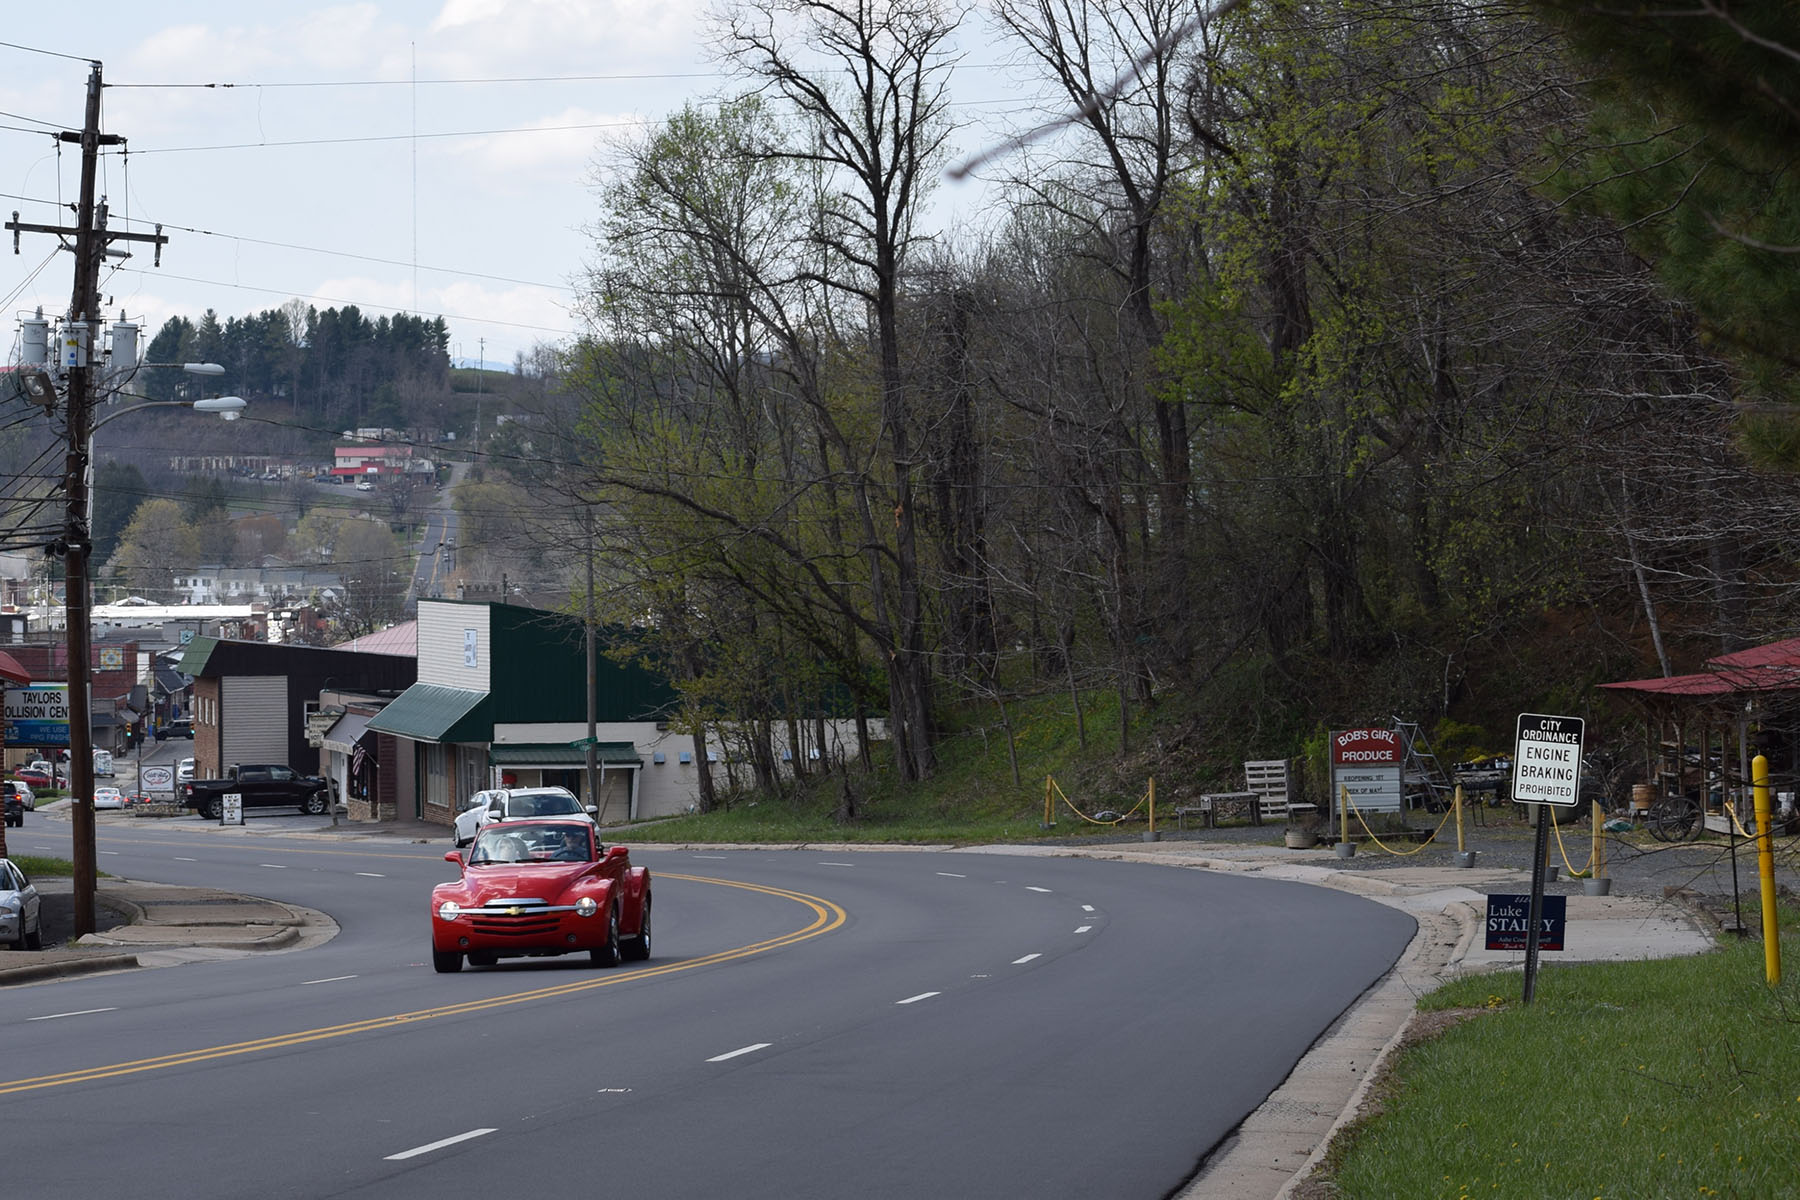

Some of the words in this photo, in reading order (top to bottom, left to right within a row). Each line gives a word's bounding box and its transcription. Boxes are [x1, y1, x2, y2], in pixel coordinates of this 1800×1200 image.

[22, 692, 61, 704] TAYLORS
[5, 706, 45, 718] OLLISION
[1540, 719, 1562, 731] CITY
[1338, 730, 1368, 746] BOB'S
[1370, 730, 1395, 744] GIRL
[1523, 730, 1578, 743] ORDINANCE
[1342, 750, 1393, 761] PRODUCE
[1526, 747, 1571, 762] ENGINE
[1521, 765, 1573, 781] BRAKING
[1519, 783, 1572, 797] PROHIBITED
[1489, 904, 1523, 917] Luke
[1489, 918, 1555, 932] STALY
